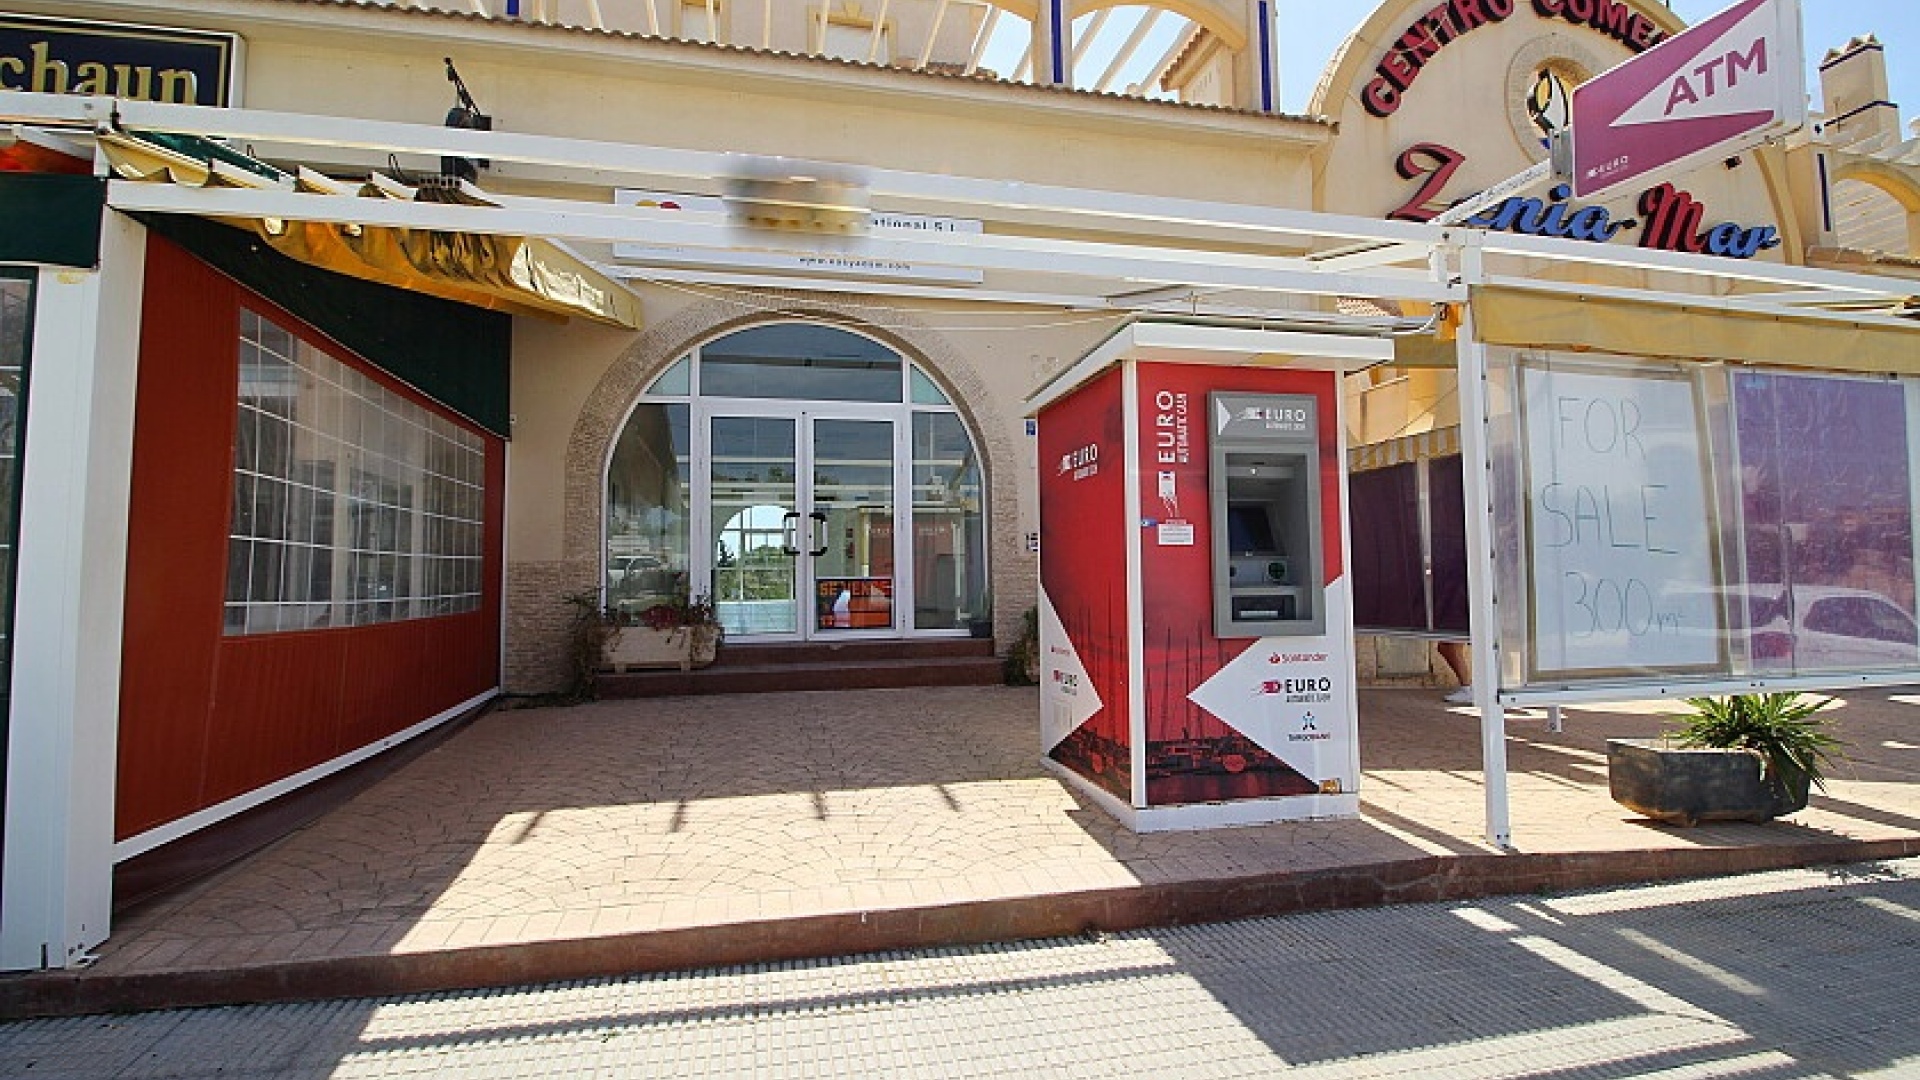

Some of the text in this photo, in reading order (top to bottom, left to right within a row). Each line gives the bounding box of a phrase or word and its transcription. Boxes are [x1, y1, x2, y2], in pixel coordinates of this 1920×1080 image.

[0, 41, 197, 106] chaun
[1362, 0, 1672, 117] CENTRO OME
[1664, 37, 1768, 116] ATM
[1387, 141, 1781, 259] Znia-Mar
[1157, 390, 1175, 463] EURO
[1265, 408, 1306, 422] EURO
[1558, 397, 1647, 461] FOR
[1073, 443, 1098, 467] EURO
[1542, 482, 1680, 555] SALE
[820, 581, 838, 596] SE
[1285, 677, 1331, 693] EURO
